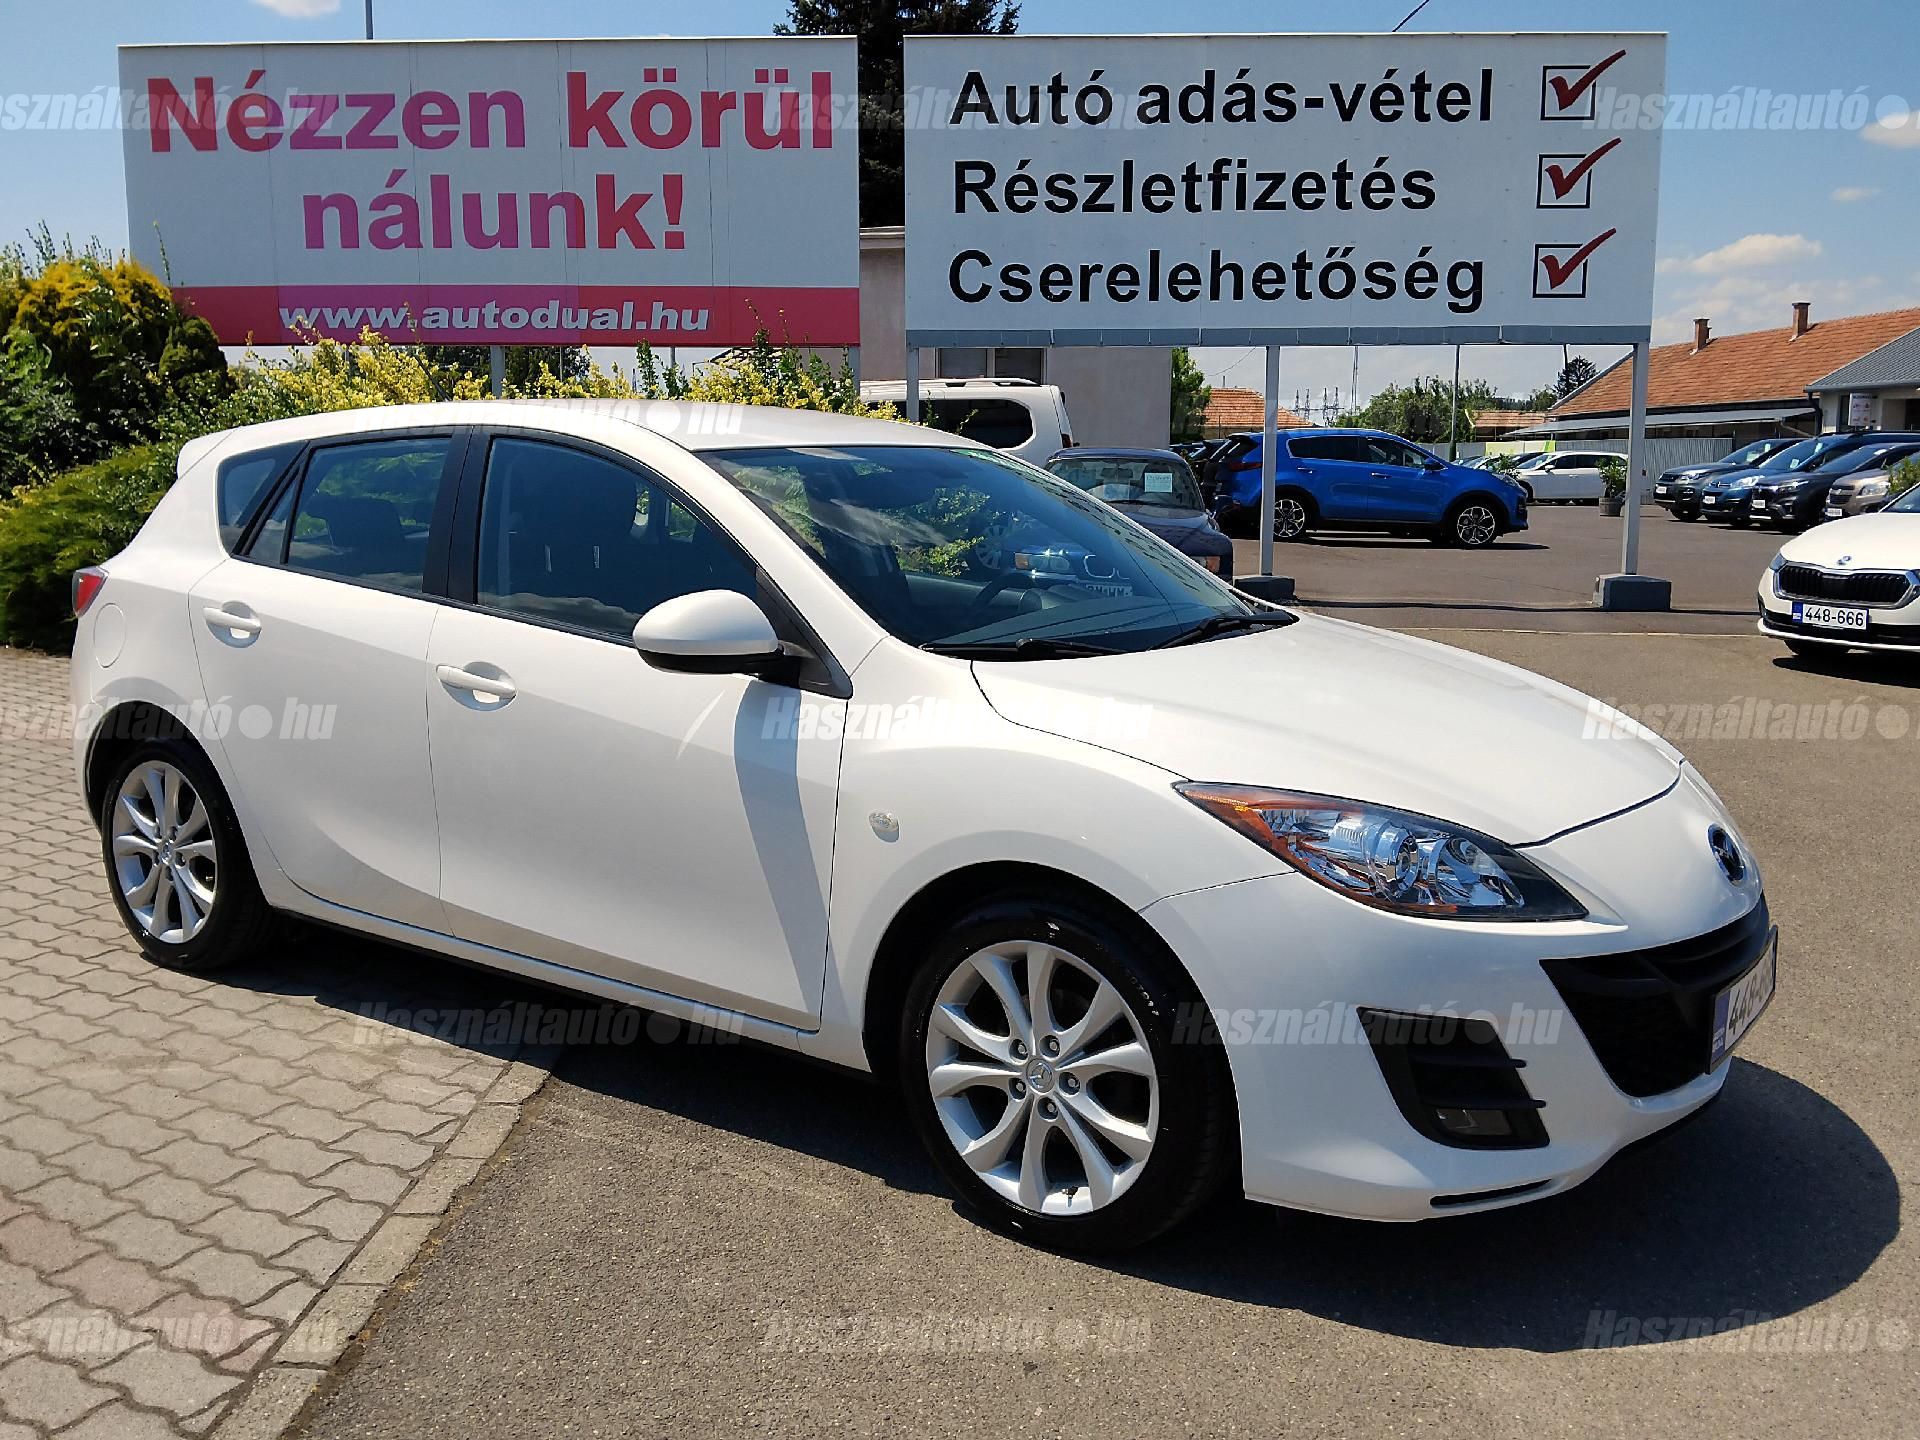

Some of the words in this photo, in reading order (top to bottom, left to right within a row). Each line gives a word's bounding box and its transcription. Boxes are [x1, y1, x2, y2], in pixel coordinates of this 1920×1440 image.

[147, 70, 526, 153] Nézzen
[567, 67, 834, 151] körül
[949, 69, 1114, 126] Autó
[1136, 67, 1494, 126] adás-vétel
[304, 169, 685, 251] nálunk!
[954, 156, 1437, 214] Részletfizetés
[948, 245, 1484, 314] Cserelehetőség
[279, 299, 710, 330] www.autodual.hu
[1805, 607, 1864, 626] 448-666
